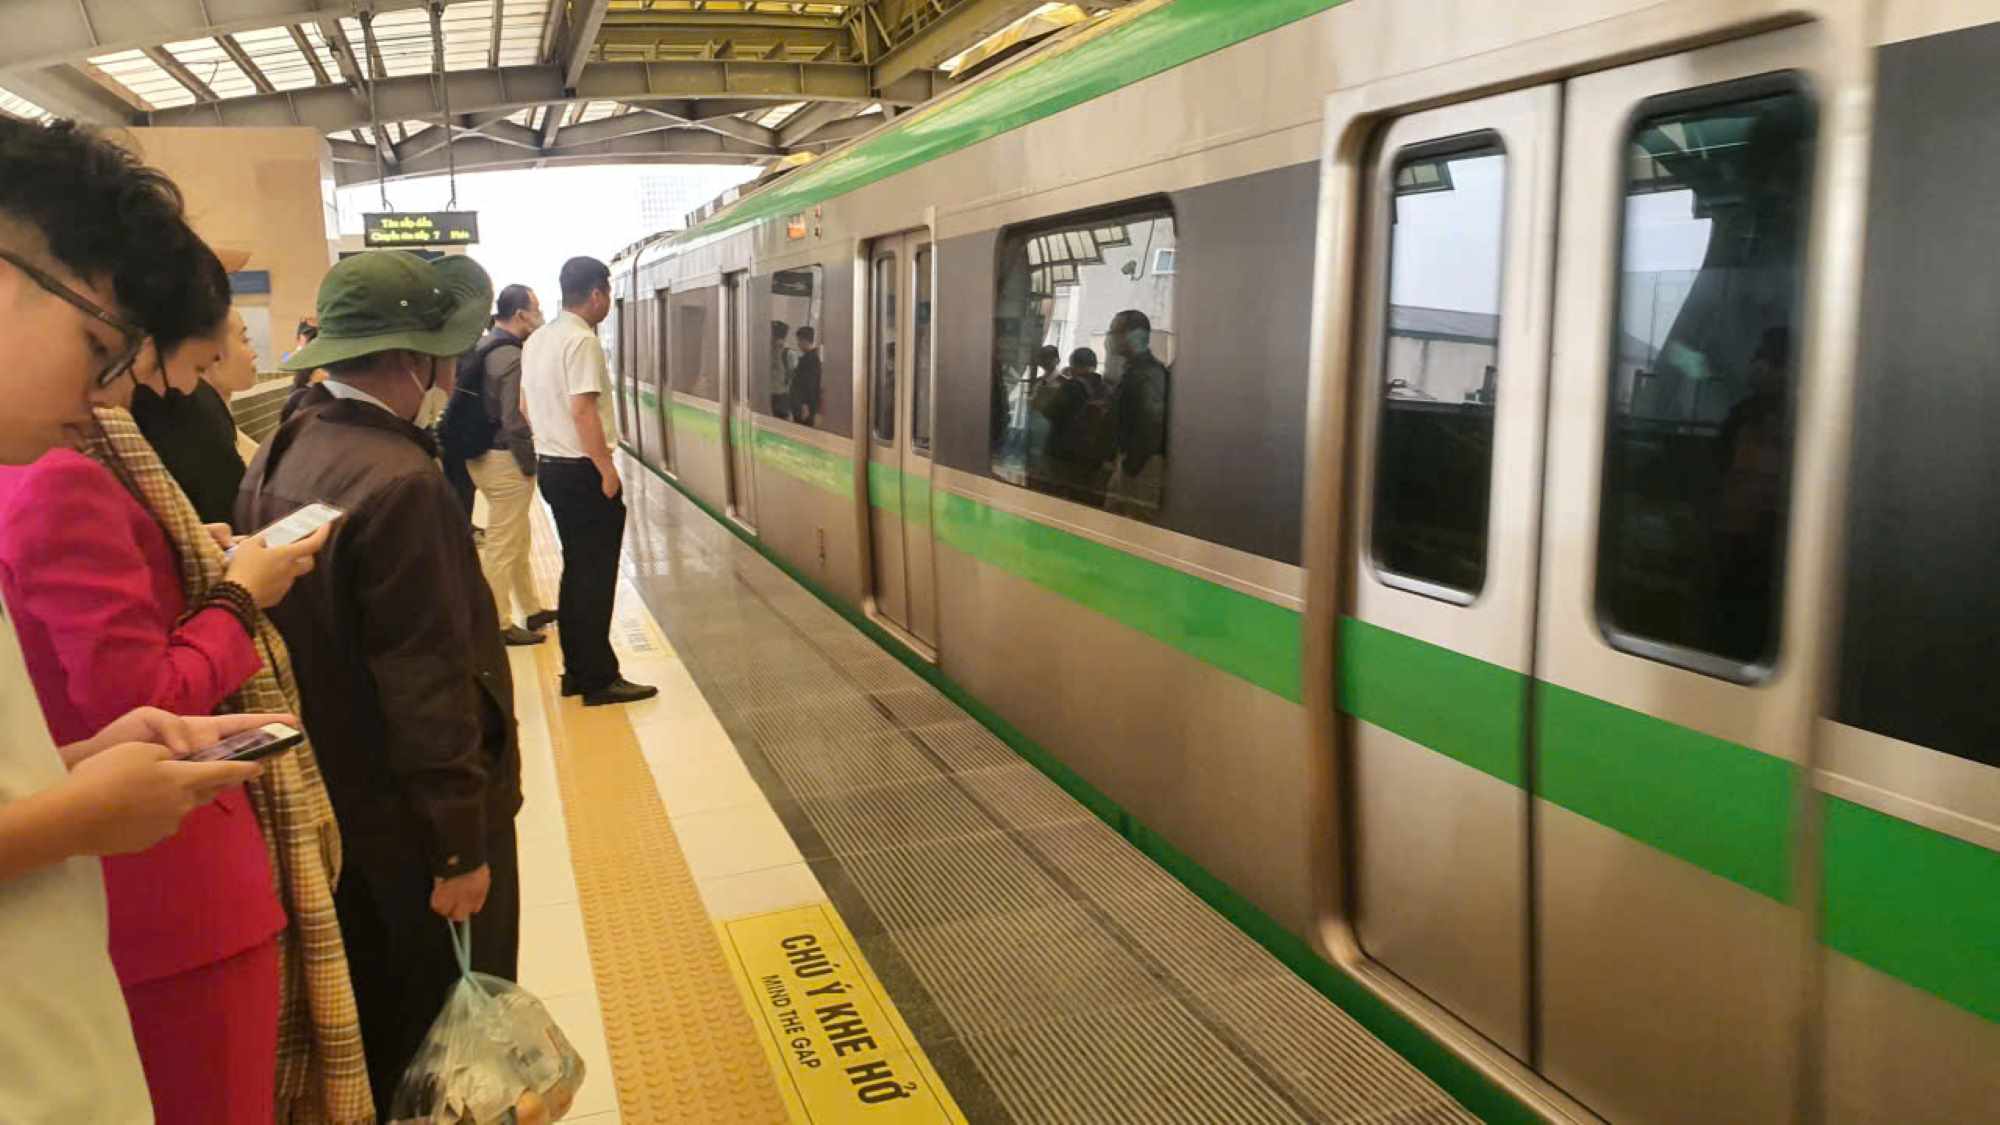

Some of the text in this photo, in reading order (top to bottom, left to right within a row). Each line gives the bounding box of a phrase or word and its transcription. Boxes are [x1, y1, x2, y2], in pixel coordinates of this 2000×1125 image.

[761, 974, 822, 1070] MIND THE GAP
[781, 933, 918, 1105] CHÚ Ý KHE HỞ
